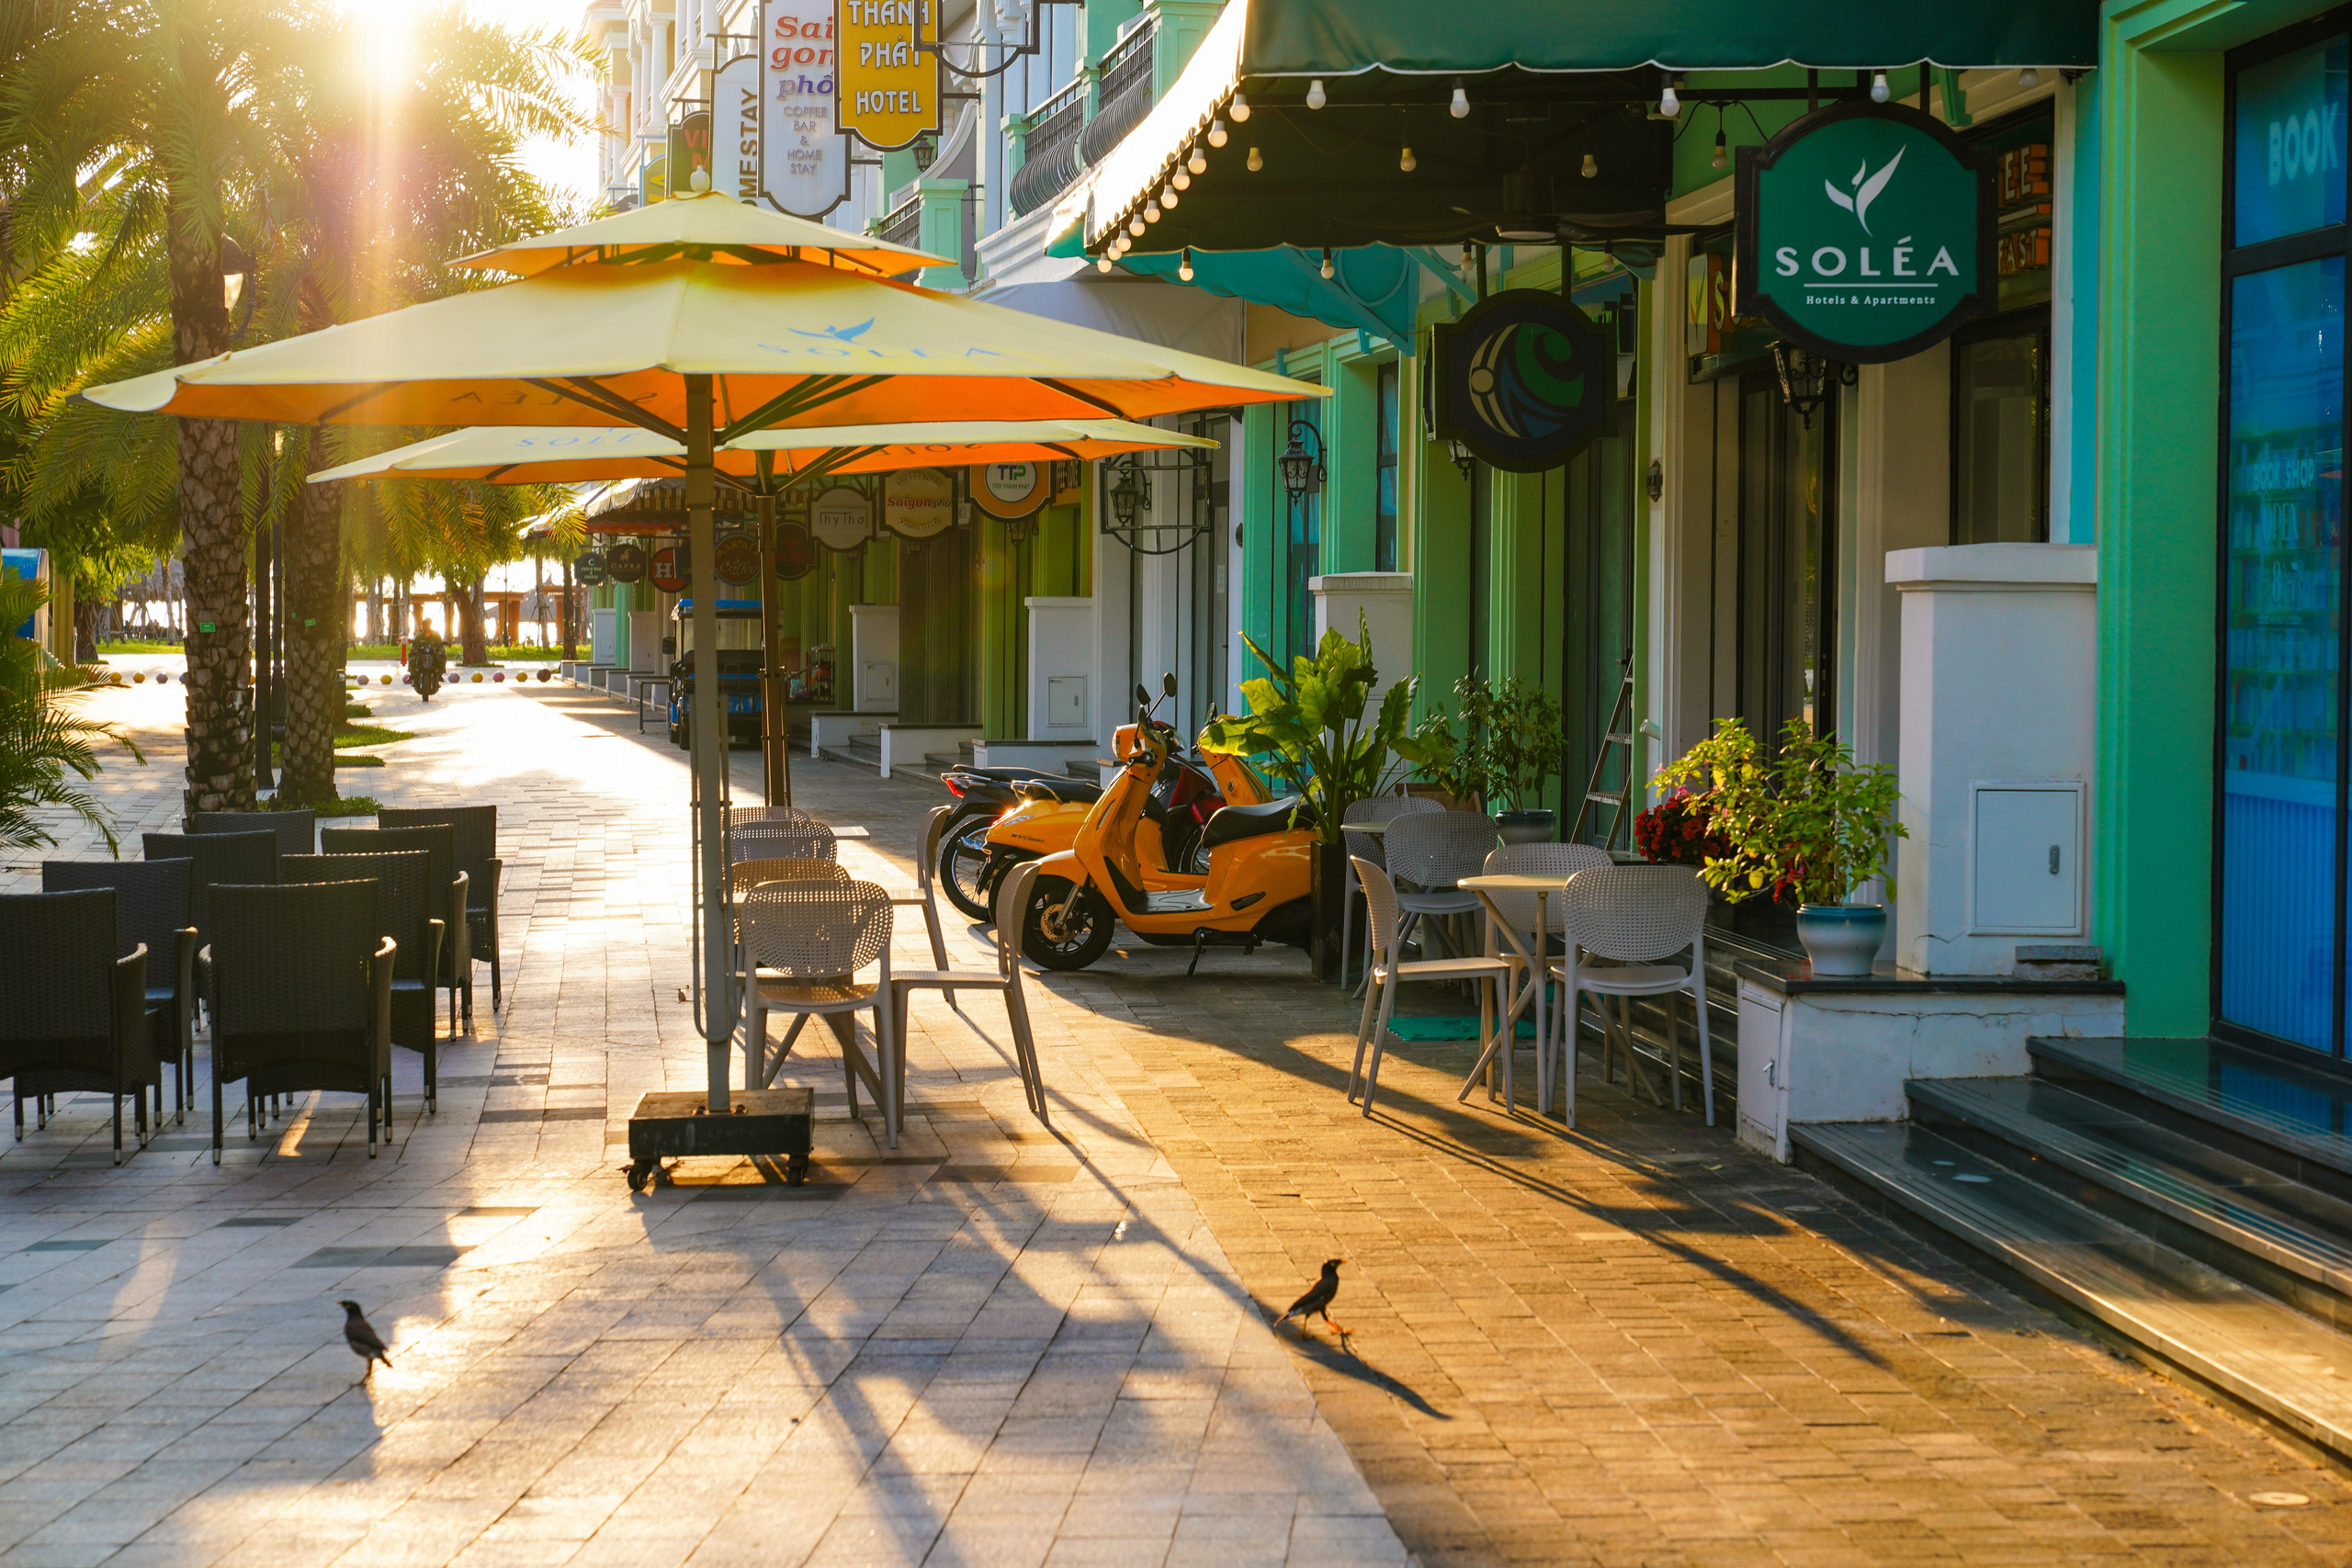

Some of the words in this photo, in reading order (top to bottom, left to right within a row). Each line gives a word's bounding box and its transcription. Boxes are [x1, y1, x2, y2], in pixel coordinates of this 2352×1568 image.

[775, 15, 833, 39] Sai
[770, 47, 833, 70] gon
[855, 90, 922, 116] HOTEL
[783, 106, 828, 118] COFFEE
[794, 120, 817, 131] BAR
[799, 135, 809, 146] &
[2268, 102, 2339, 186] BOOK
[787, 149, 823, 161] HOME
[790, 163, 817, 175] STAY
[1775, 235, 1960, 276] SOLÉA
[1806, 295, 1846, 305] Hotels
[1850, 296, 1860, 305] &
[1864, 295, 1936, 307] Apartments
[997, 464, 1026, 481] TTP
[2254, 461, 2281, 491] BOOK
[2285, 457, 2314, 490] SHOP
[887, 497, 932, 510] Saigon
[654, 562, 677, 578] H
[720, 558, 758, 576] Coffee
